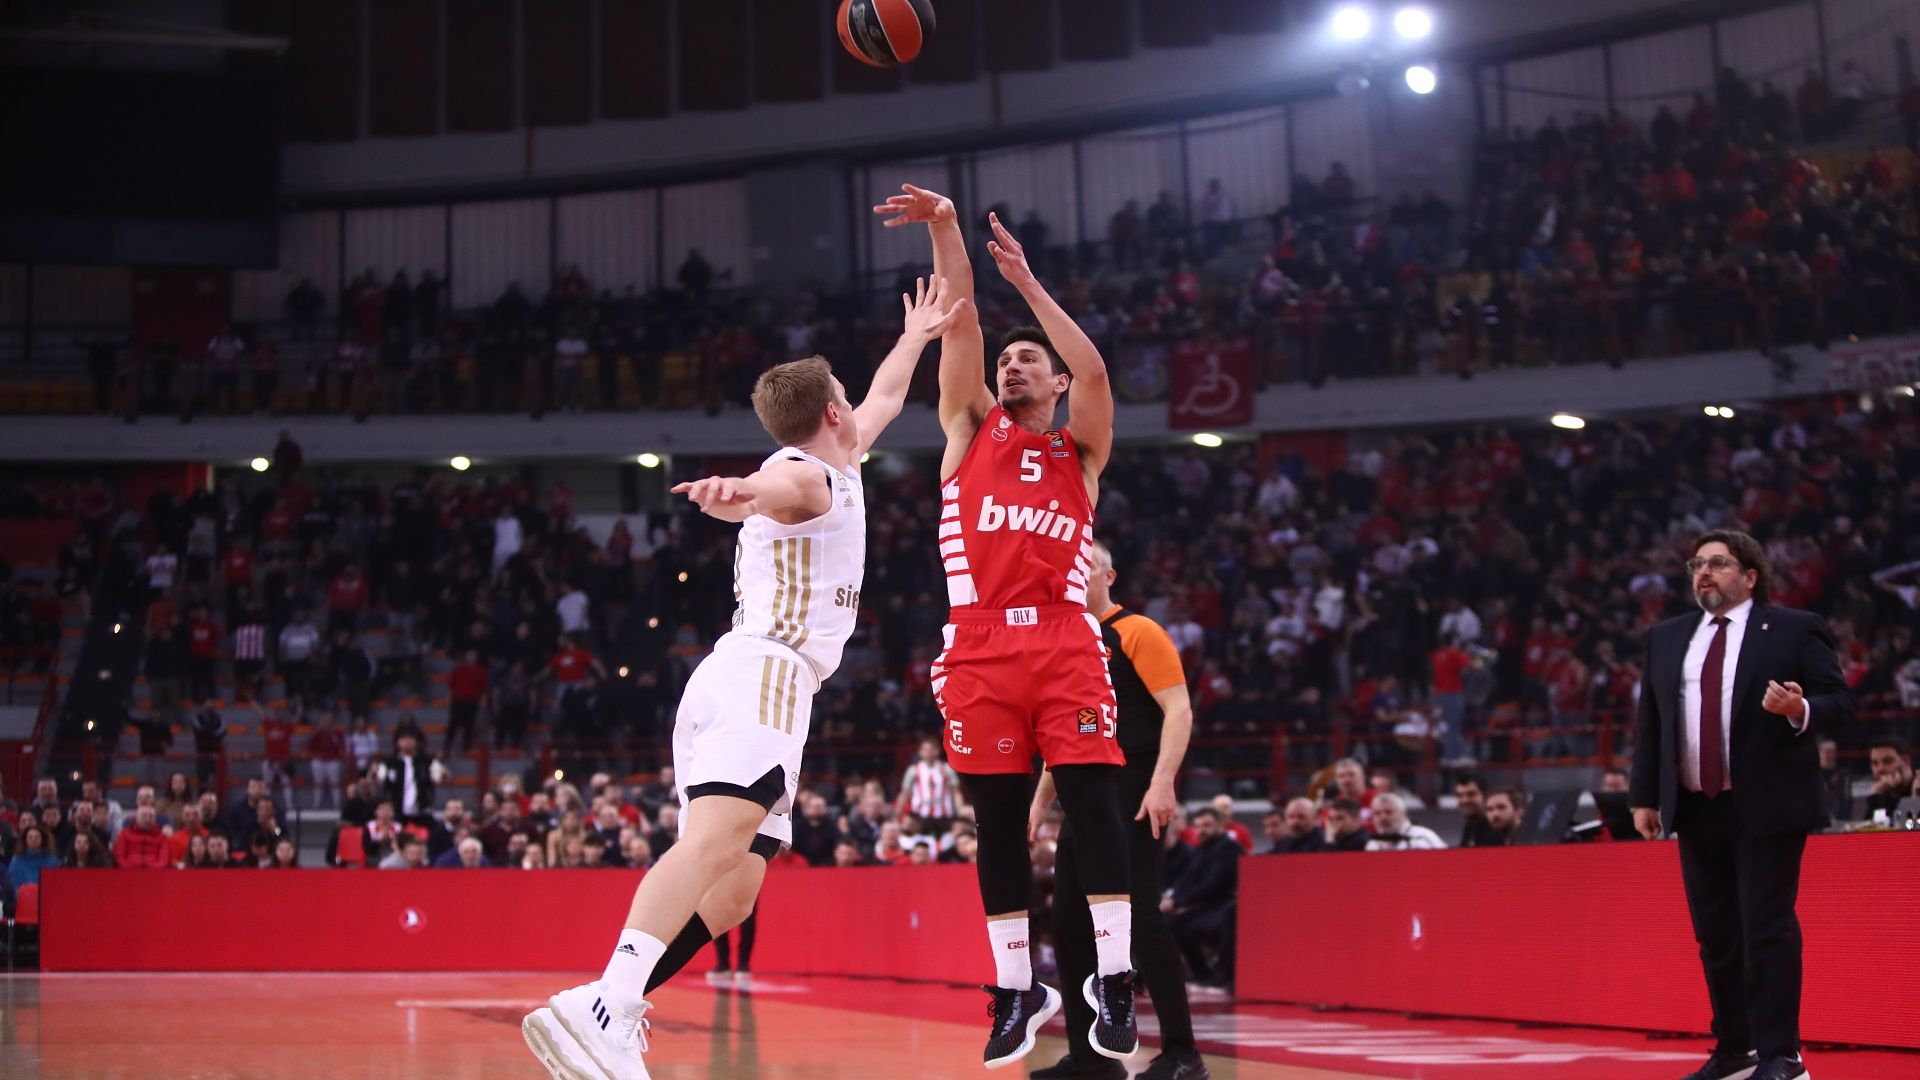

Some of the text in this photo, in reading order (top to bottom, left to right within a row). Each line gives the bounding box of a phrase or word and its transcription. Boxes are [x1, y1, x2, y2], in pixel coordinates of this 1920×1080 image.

[1020, 448, 1042, 482] 5
[977, 494, 1077, 542] bwin
[1013, 609, 1030, 623] OLY
[1094, 929, 1111, 938] SA
